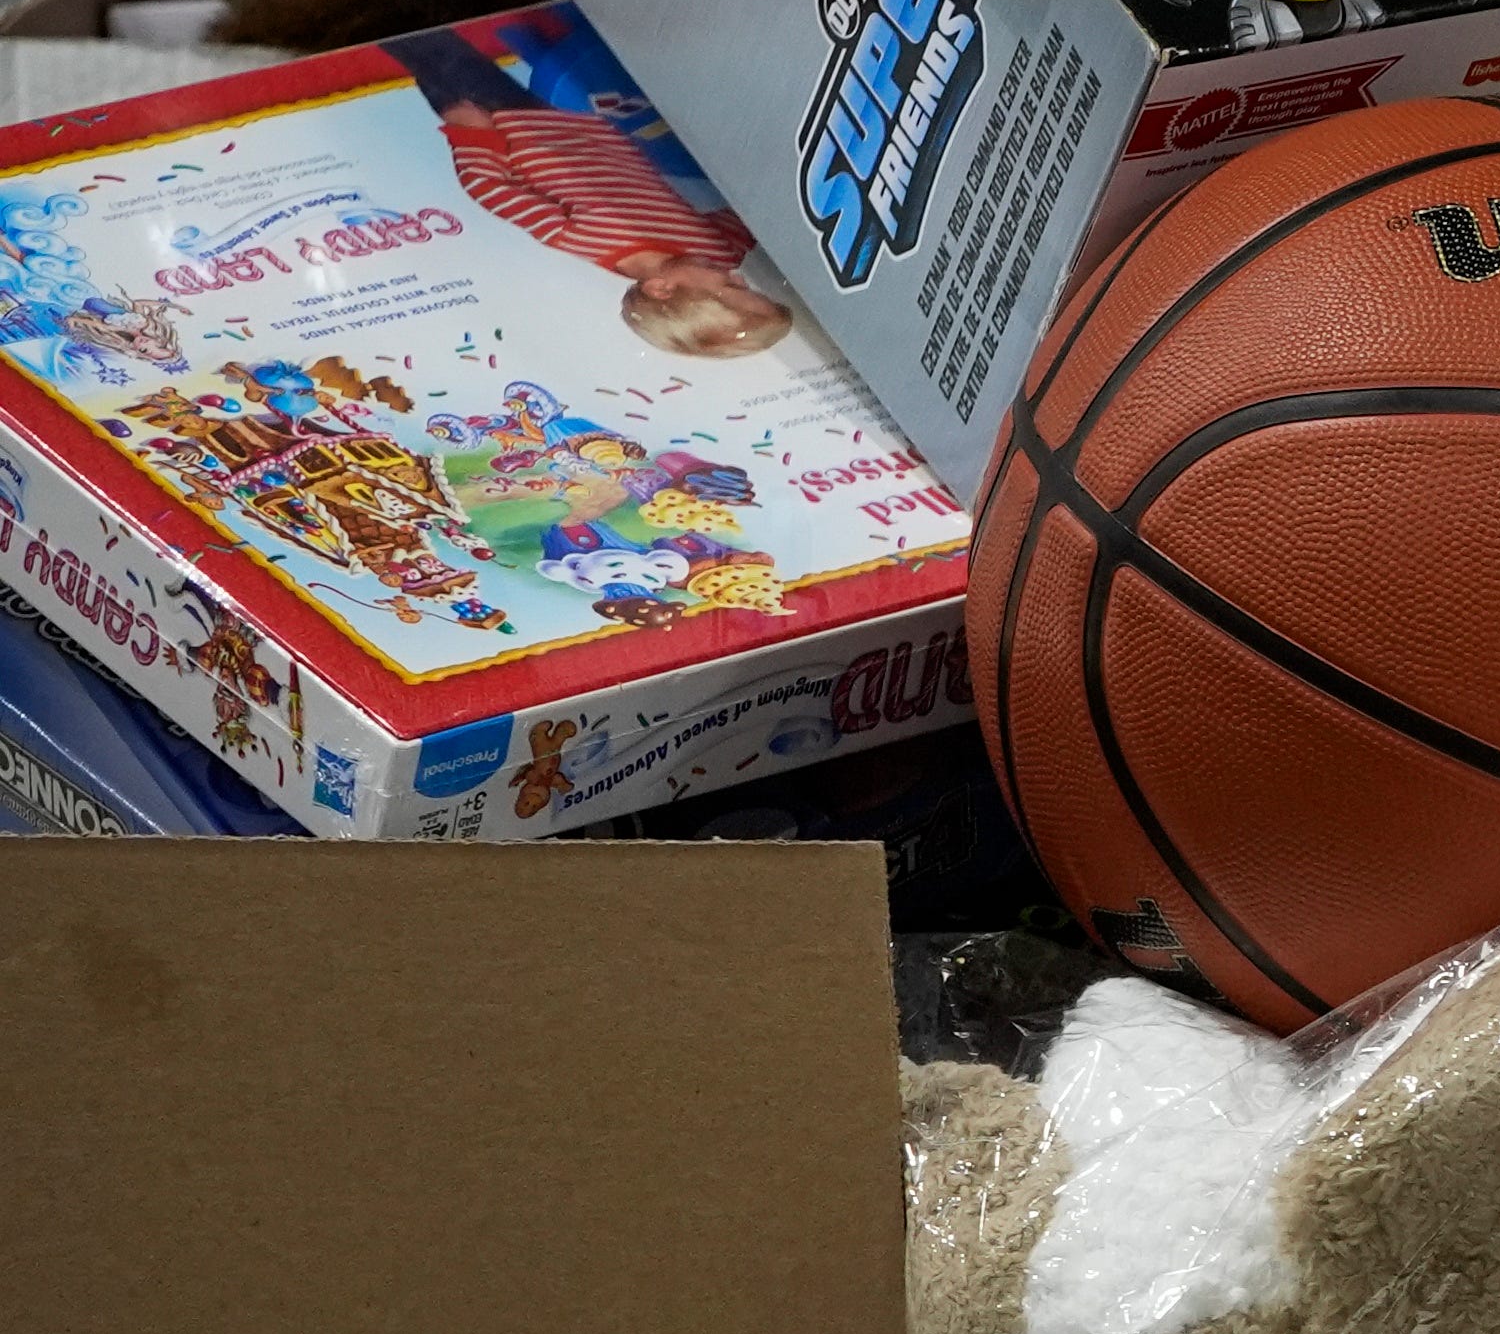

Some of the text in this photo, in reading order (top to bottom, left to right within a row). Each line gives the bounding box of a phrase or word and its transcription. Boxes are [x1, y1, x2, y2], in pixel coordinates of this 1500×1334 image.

[948, 193, 974, 243] ROBO
[966, 104, 1004, 198] COMMAND
[999, 37, 1033, 112] CENTER
[1171, 101, 1244, 139] MATTEL
[1252, 87, 1344, 116] next generation
[155, 208, 463, 296] CANDY LAND
[921, 303, 954, 378] CENTRO
[946, 279, 964, 314] DE
[956, 196, 995, 289] COMANDO
[1021, 91, 1038, 121] DE
[1031, 22, 1066, 99] BATMAN
[938, 44, 1084, 401] CENTRE DE COMMANDEMENT ROBOT BATMAN
[956, 349, 989, 425] CENTRO
[981, 325, 999, 361] DE
[991, 245, 1031, 337] COMANDO
[1068, 68, 1103, 146] BATMAN
[24, 533, 161, 667] CANDY
[423, 747, 499, 780] Preschool
[463, 791, 487, 811] 3+
[563, 677, 833, 809] Kingdom of Sweet Adventures
